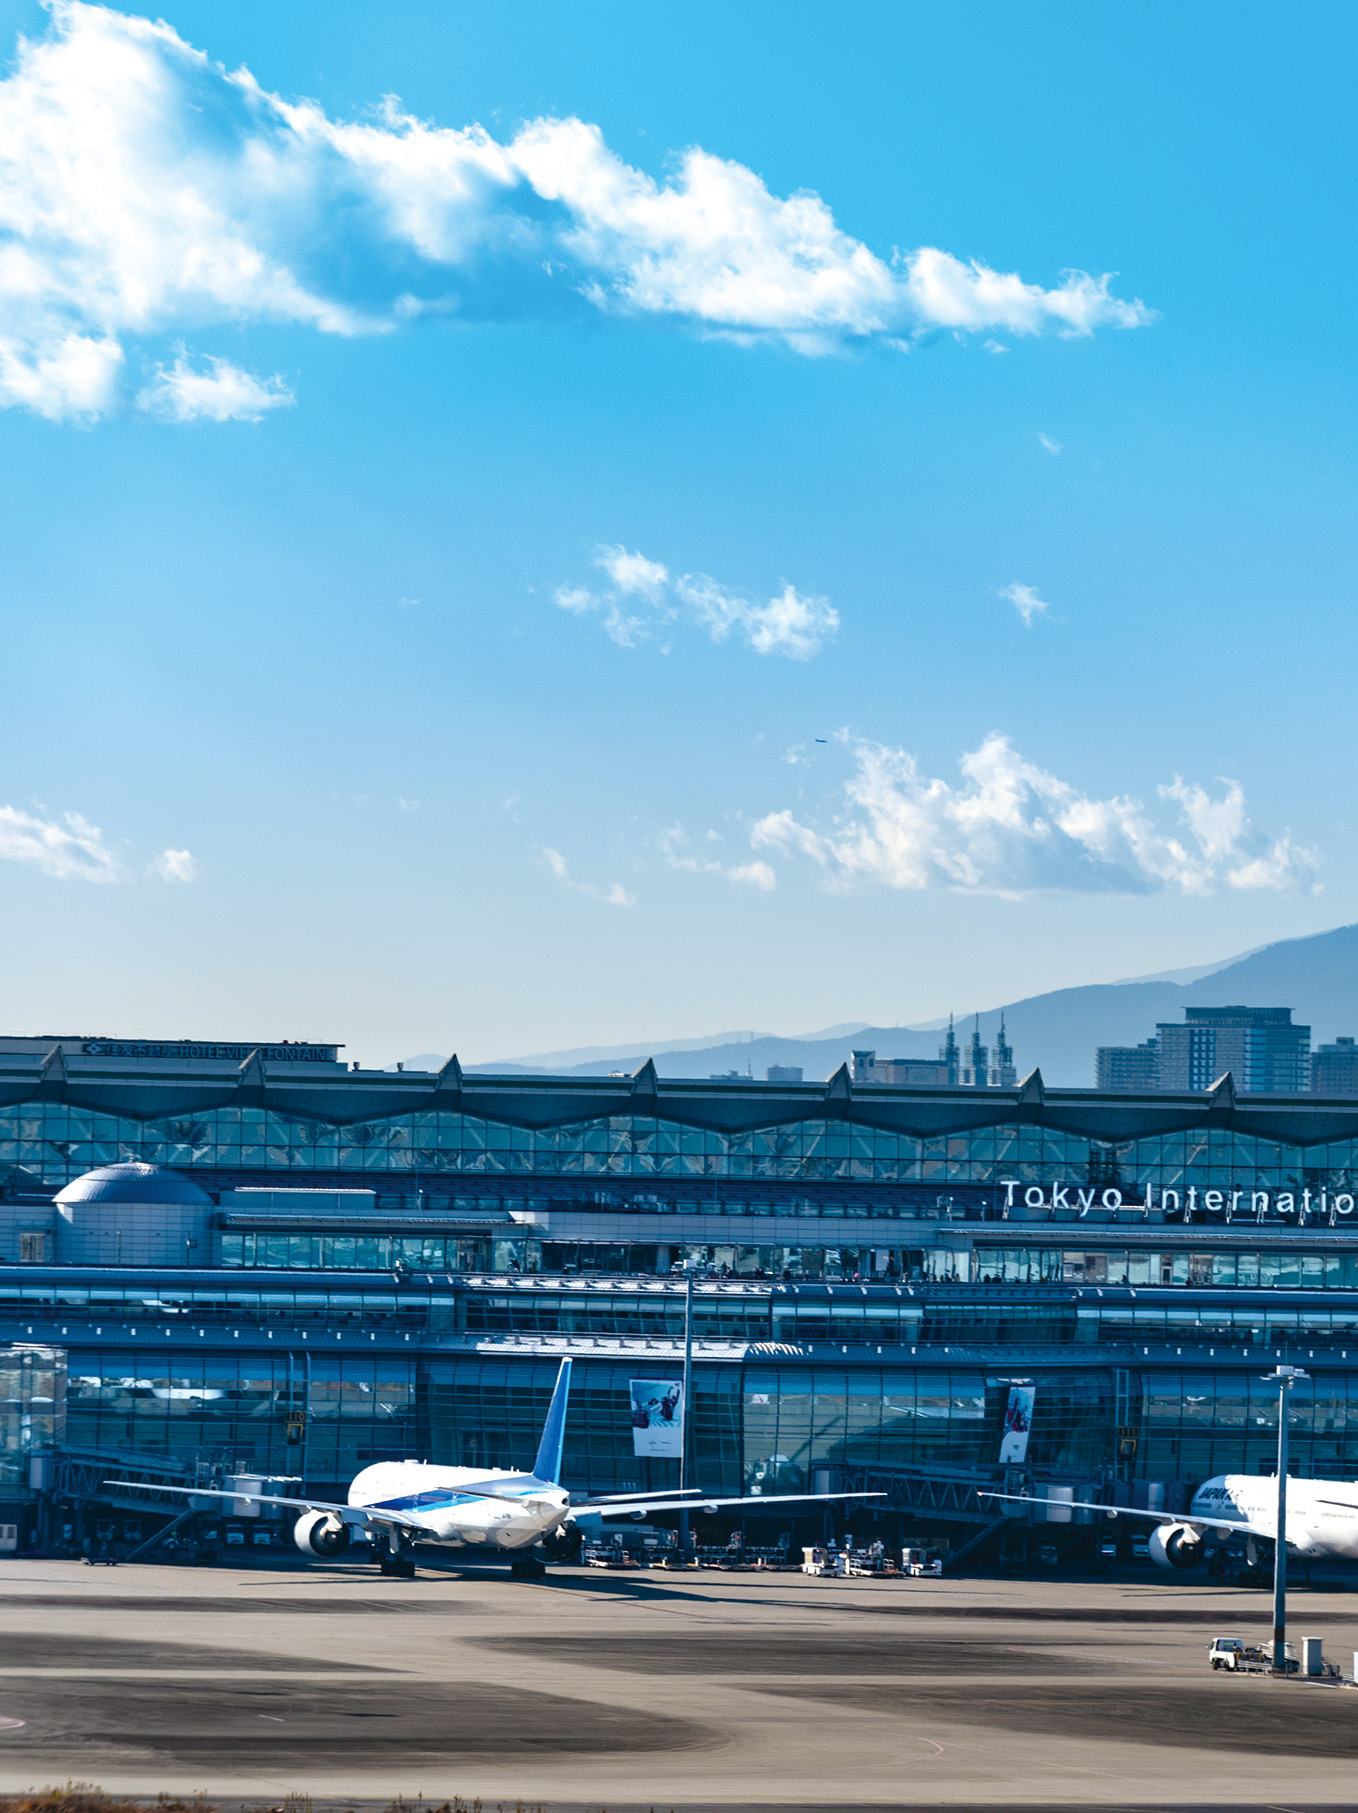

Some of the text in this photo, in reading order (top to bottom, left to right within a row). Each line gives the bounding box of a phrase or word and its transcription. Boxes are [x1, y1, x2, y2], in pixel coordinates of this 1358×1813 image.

[180, 1045, 333, 1061] HOTEL VIL FONTAINE
[1000, 1181, 1122, 1217] Tokyo
[289, 1412, 305, 1421] 110
